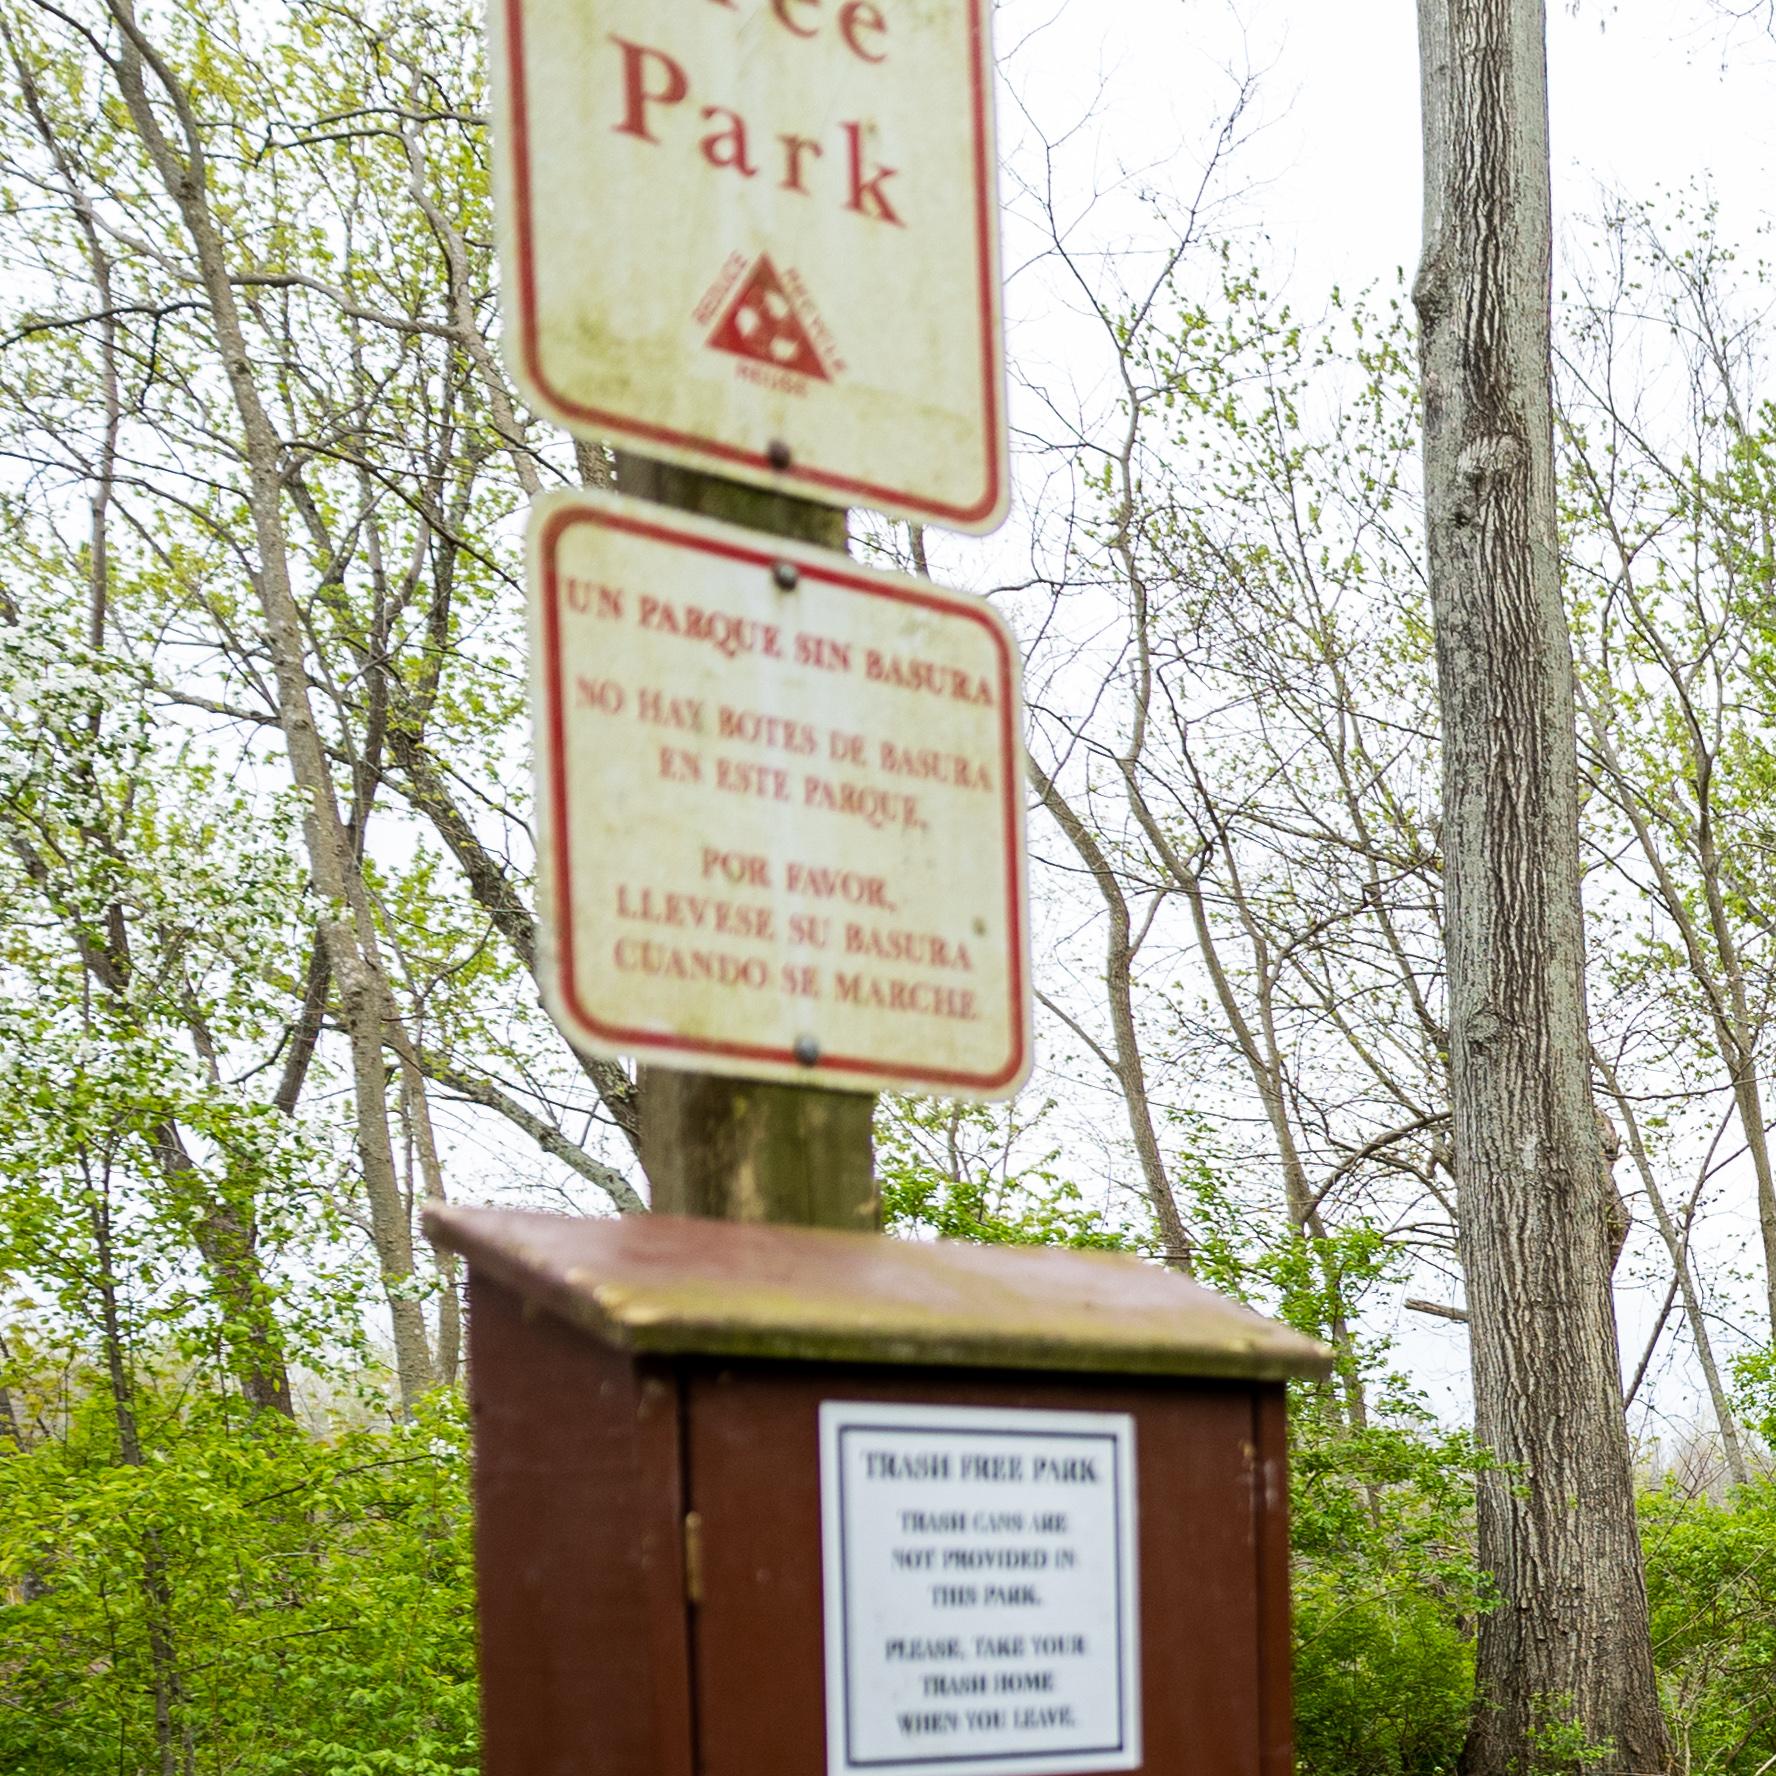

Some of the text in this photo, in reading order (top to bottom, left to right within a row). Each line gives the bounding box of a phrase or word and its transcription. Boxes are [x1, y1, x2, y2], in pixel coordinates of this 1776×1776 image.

[606, 33, 907, 229] Park
[565, 577, 994, 707] UN PARQUE SIN BASURA
[575, 674, 993, 792] NO HAY BOTES DE BASURA
[658, 746, 702, 783] EN
[714, 755, 789, 802] ESTE
[700, 847, 772, 888] POR
[615, 883, 973, 972] LLEVESE SU BASURA
[613, 936, 769, 990] CUANDO
[782, 962, 820, 999] SE
[863, 1451, 1099, 1483] TRASH FREE PARK
[899, 1510, 1068, 1533] TRASH CANS ARE
[891, 1548, 1077, 1570] NOT PROVIDED IN
[929, 1584, 978, 1607] THIS
[975, 1634, 1026, 1657] TAKE
[1031, 1633, 1085, 1656] YOUR
[921, 1671, 1054, 1697] TRASH HOME
[897, 1710, 960, 1735] WHEN
[966, 1708, 1006, 1731] YOU
